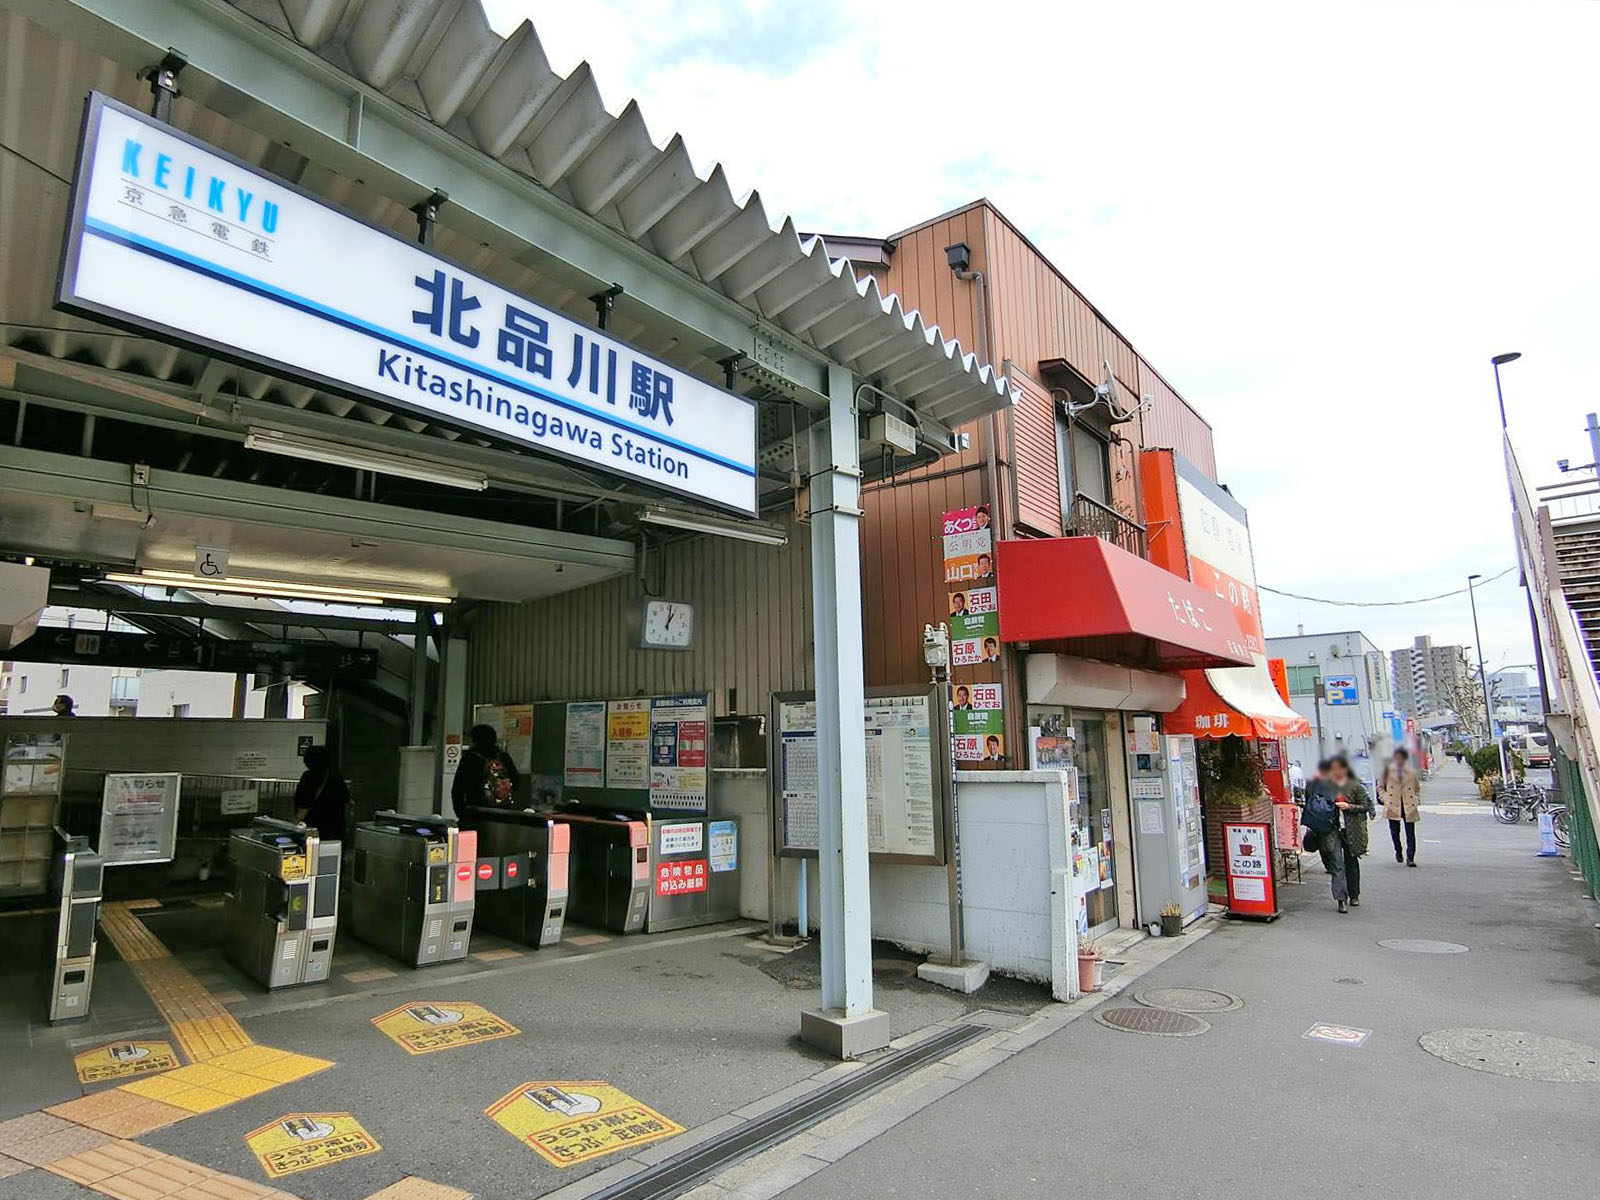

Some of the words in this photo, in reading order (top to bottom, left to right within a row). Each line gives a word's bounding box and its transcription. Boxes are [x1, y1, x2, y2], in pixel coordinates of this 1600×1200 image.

[121, 138, 279, 234] KEIKYU
[124, 184, 270, 257] 京急電鉄
[411, 269, 674, 427] 北品川駅
[378, 349, 602, 450] Kitashinagawa
[611, 433, 689, 479] Station
[944, 518, 972, 533] あくつ
[949, 536, 987, 552] 公明党
[946, 564, 972, 580] 山口
[969, 592, 991, 605] 石田
[969, 603, 996, 613] ひでお
[1167, 591, 1213, 632] たばこ
[953, 642, 975, 655] 石原
[954, 654, 982, 664] ひろたか
[973, 689, 995, 700] 石田
[1327, 690, 1345, 705] P
[973, 701, 1000, 709] ひでお
[1195, 713, 1229, 729] 珈琲
[955, 738, 977, 750] 石原
[956, 751, 982, 759] ひろたか
[661, 865, 703, 878] 危険物品
[661, 878, 703, 892] 持込み厳禁
[538, 1110, 646, 1144] うらが黒い
[270, 1134, 362, 1160] うらが黒い
